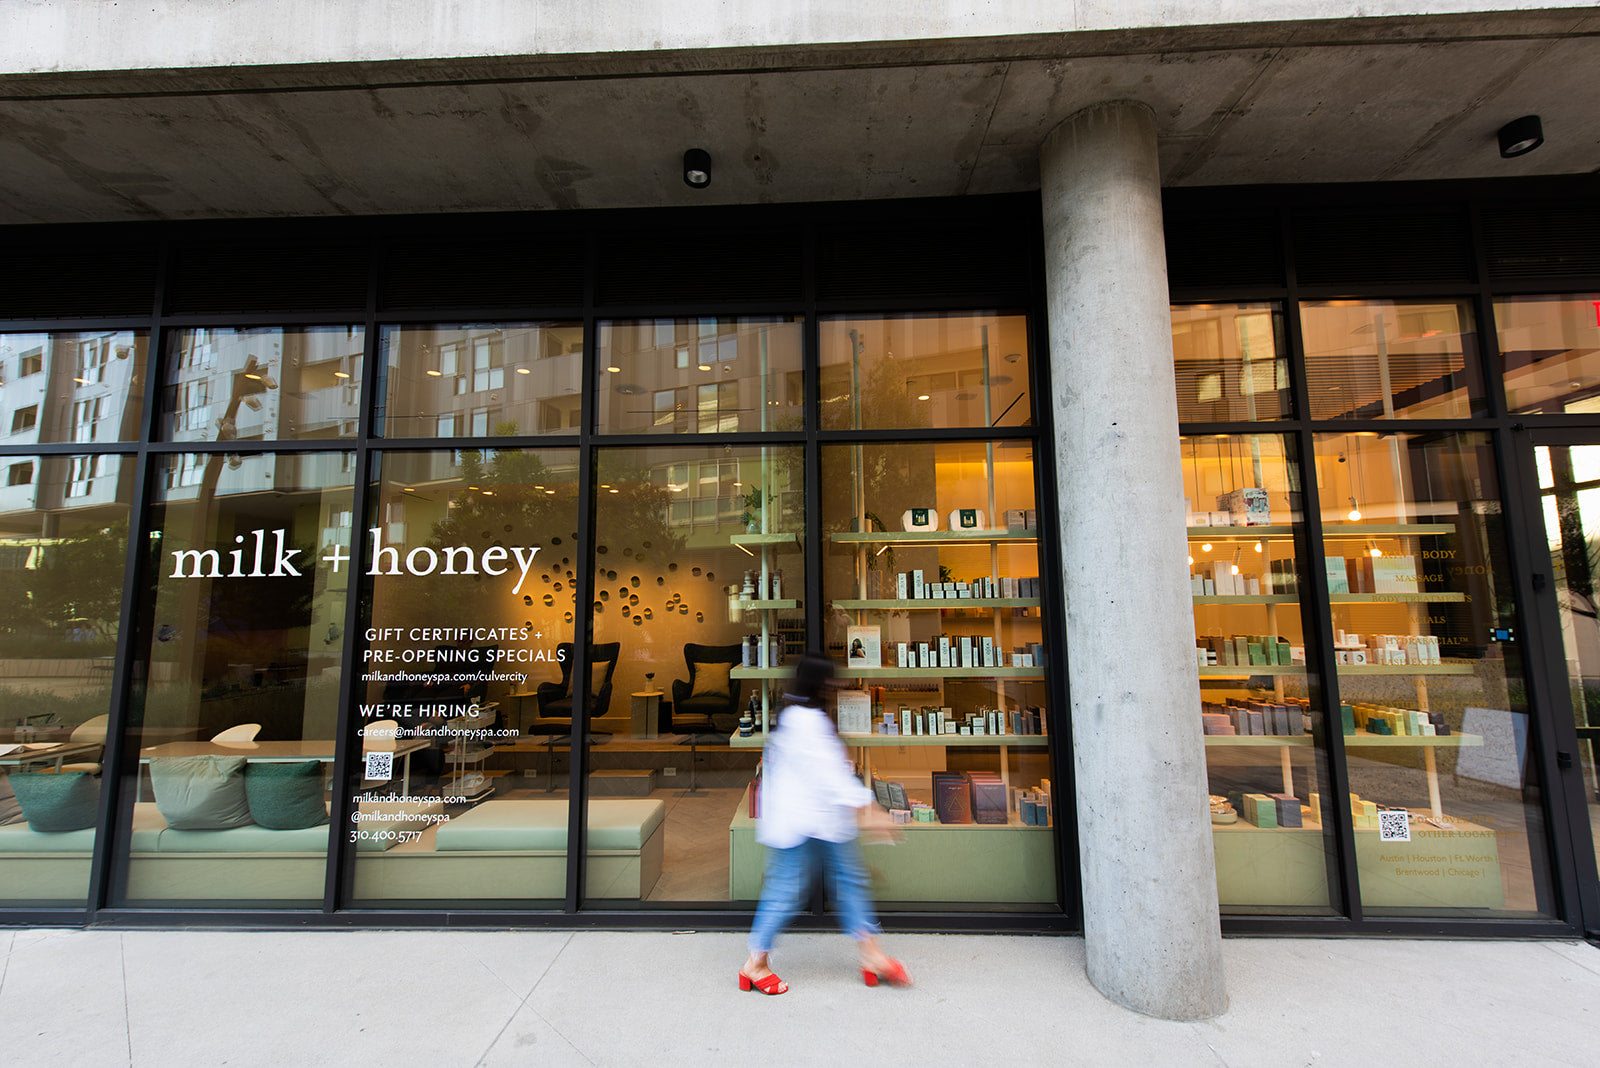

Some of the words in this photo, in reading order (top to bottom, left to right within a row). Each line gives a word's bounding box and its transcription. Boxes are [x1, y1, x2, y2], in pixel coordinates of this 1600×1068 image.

[168, 528, 302, 578] milk
[322, 544, 350, 573] +
[365, 527, 541, 595] honey
[1422, 550, 1457, 560] BODY
[1395, 574, 1445, 583] MASSAGE
[1372, 595, 1401, 603] BODY
[1404, 594, 1473, 603] TREATMENTS
[365, 628, 404, 641] GIFT
[409, 628, 529, 641] CERTIFICATES
[535, 631, 543, 640] +
[363, 649, 480, 663] PRE-OPENING
[485, 649, 566, 662] SPECIALS
[361, 670, 528, 685] milkandhoneyspa.com/culvercity
[1409, 679, 1454, 688] WAXING
[419, 704, 480, 718] HIRING
[357, 726, 519, 740] careers@milkandhoneyspa.com
[352, 792, 467, 807] milkandhoneyspa.com
[351, 810, 450, 825] @milkandhoneyspa
[349, 830, 423, 843] 310.400.5717
[1418, 830, 1455, 839] OTHER
[1457, 830, 1519, 839] LOCATIONS
[1379, 854, 1405, 862] Austin
[1412, 854, 1447, 862] Houston
[1465, 854, 1494, 862] Worth
[1395, 867, 1440, 876] Brentwood
[1447, 867, 1480, 878] Chicago
